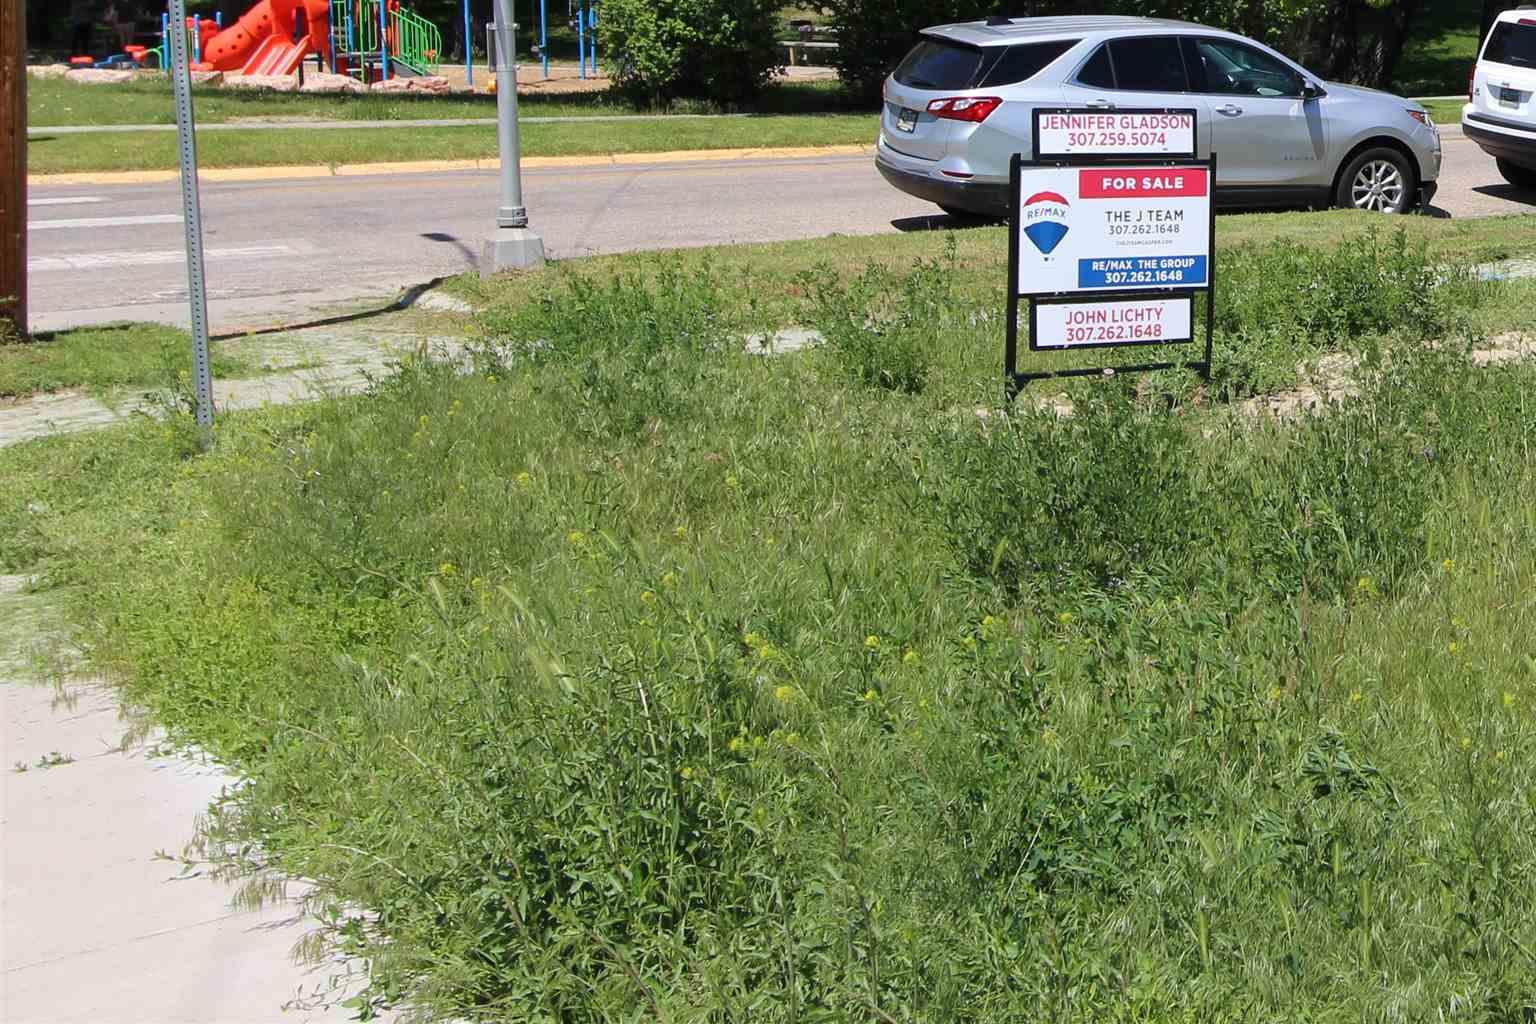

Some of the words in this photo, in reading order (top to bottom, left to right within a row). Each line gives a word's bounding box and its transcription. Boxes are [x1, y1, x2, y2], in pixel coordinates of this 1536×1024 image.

[1042, 116, 1115, 130] JENNIFER
[1120, 116, 1190, 129] GLADSON
[1068, 131, 1166, 147] 307.259.5074
[1102, 178, 1136, 191] FOR
[1142, 176, 1184, 190] SALE
[1027, 207, 1066, 220] RE/MAX
[1105, 210, 1132, 223] THE
[1136, 210, 1143, 223] J
[1147, 209, 1184, 222] TEAM
[1108, 224, 1180, 236] 307.262.1648
[1092, 260, 1132, 272] RE/MAX
[1138, 259, 1158, 269] THE
[1160, 258, 1196, 269] GROUP
[1105, 270, 1183, 284] 307.262.1648
[1066, 310, 1107, 325] JOHN
[1111, 308, 1162, 323] LICHTY
[1066, 326, 1162, 342] 307.262.1648
